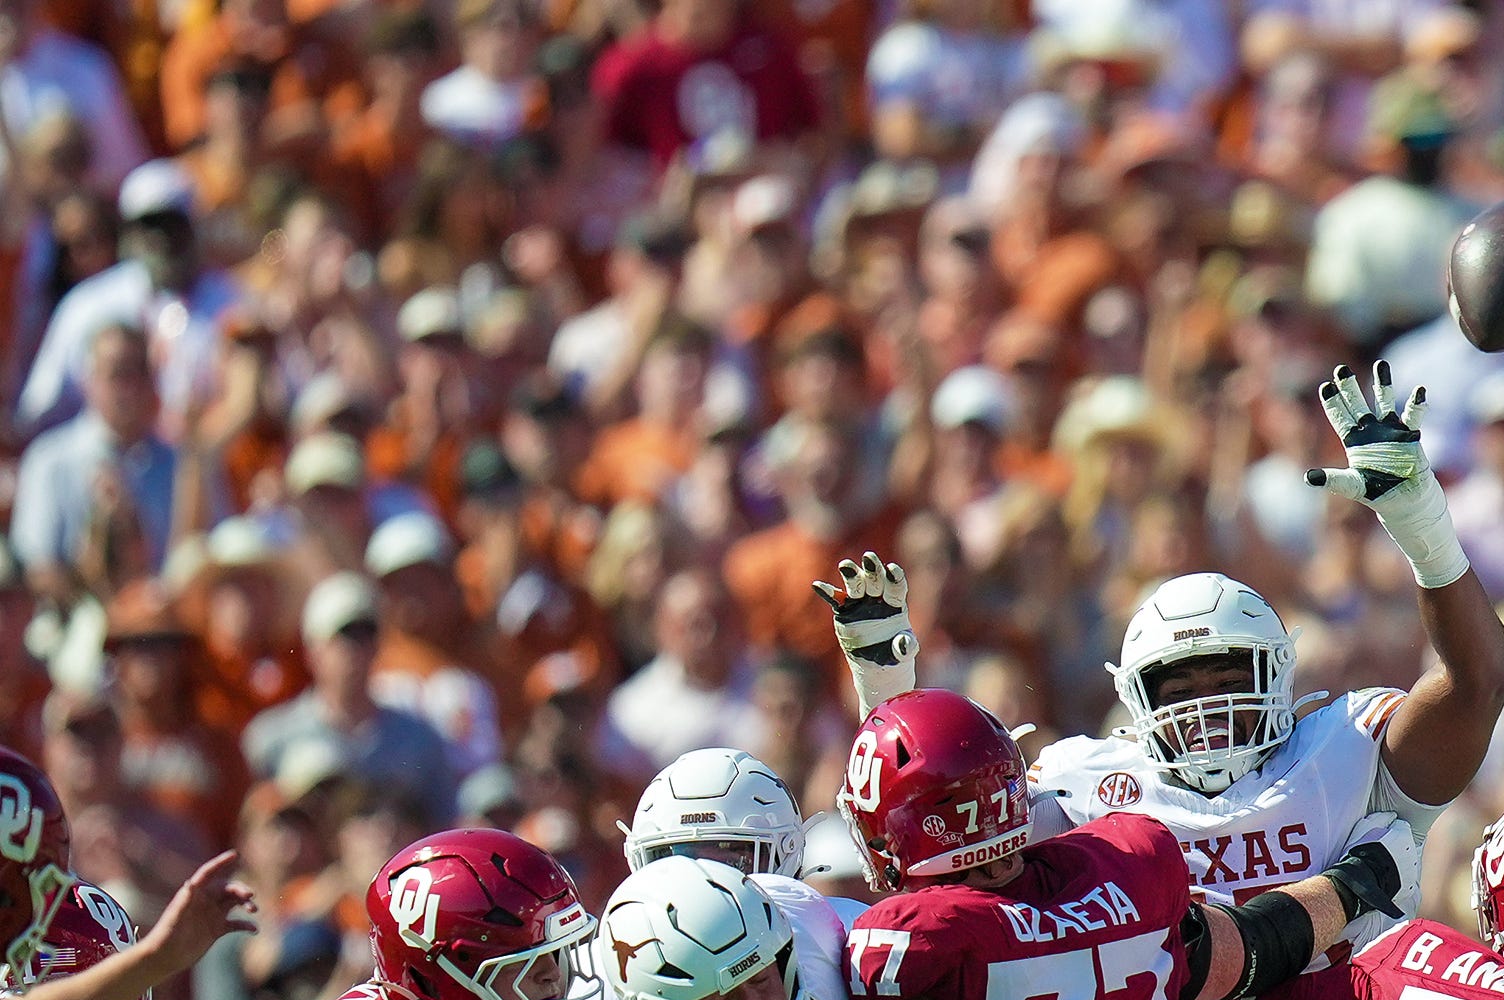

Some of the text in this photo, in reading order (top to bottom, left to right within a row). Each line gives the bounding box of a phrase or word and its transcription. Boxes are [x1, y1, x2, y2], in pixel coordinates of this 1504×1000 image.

[1173, 627, 1211, 642] HORNS
[1099, 773, 1141, 806] SEC
[680, 812, 717, 825] HORNS
[922, 814, 946, 837] SEC
[956, 788, 1009, 835] 77
[951, 831, 1028, 869] SOONERS
[389, 866, 441, 949] OU
[728, 951, 761, 979] HORNS
[845, 928, 911, 996] 77
[1401, 931, 1444, 976] B.
